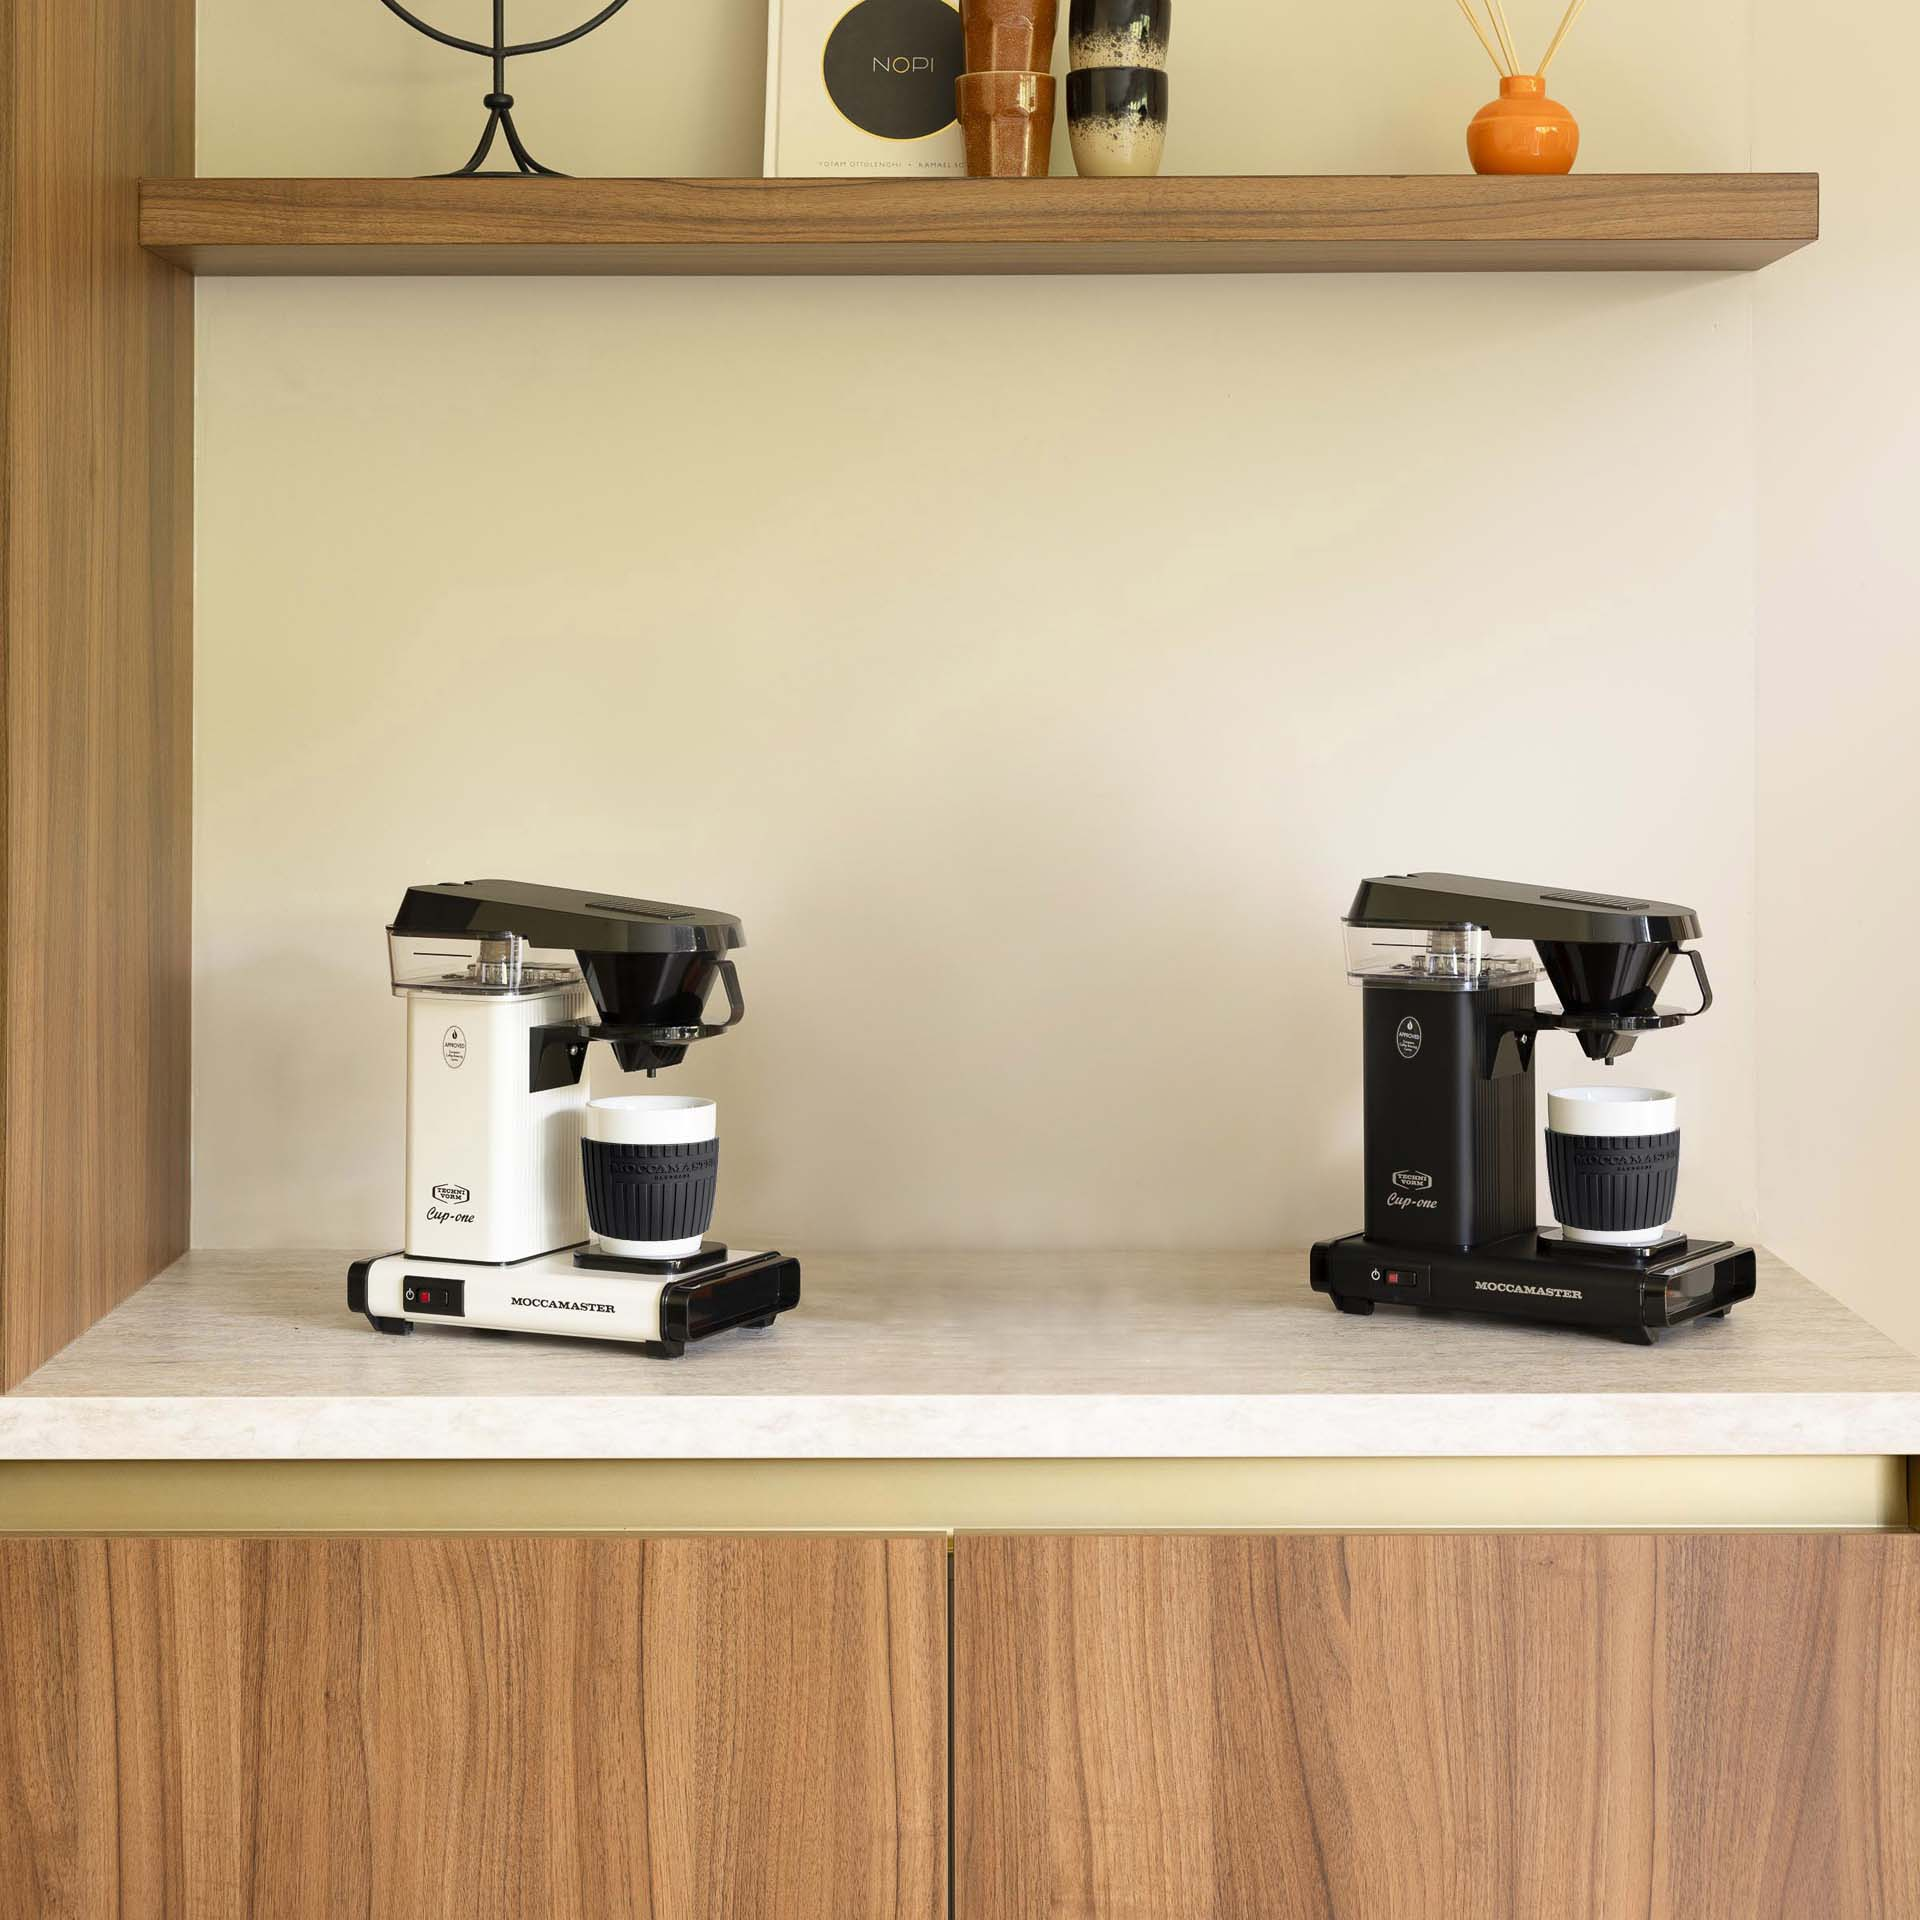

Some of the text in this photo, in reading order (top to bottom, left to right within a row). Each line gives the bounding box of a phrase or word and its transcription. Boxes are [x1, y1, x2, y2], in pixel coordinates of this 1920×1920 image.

[872, 56, 934, 73] NOPI
[1397, 1173, 1427, 1182] TECHNI
[437, 1187, 465, 1195] TECHNI
[440, 1193, 462, 1201] VORM
[1387, 1192, 1438, 1210] Cup-one
[426, 1206, 475, 1224] Cup-one
[1474, 1280, 1583, 1300] MOCCAMASTER
[511, 1296, 616, 1314] MOCCAMASTER
